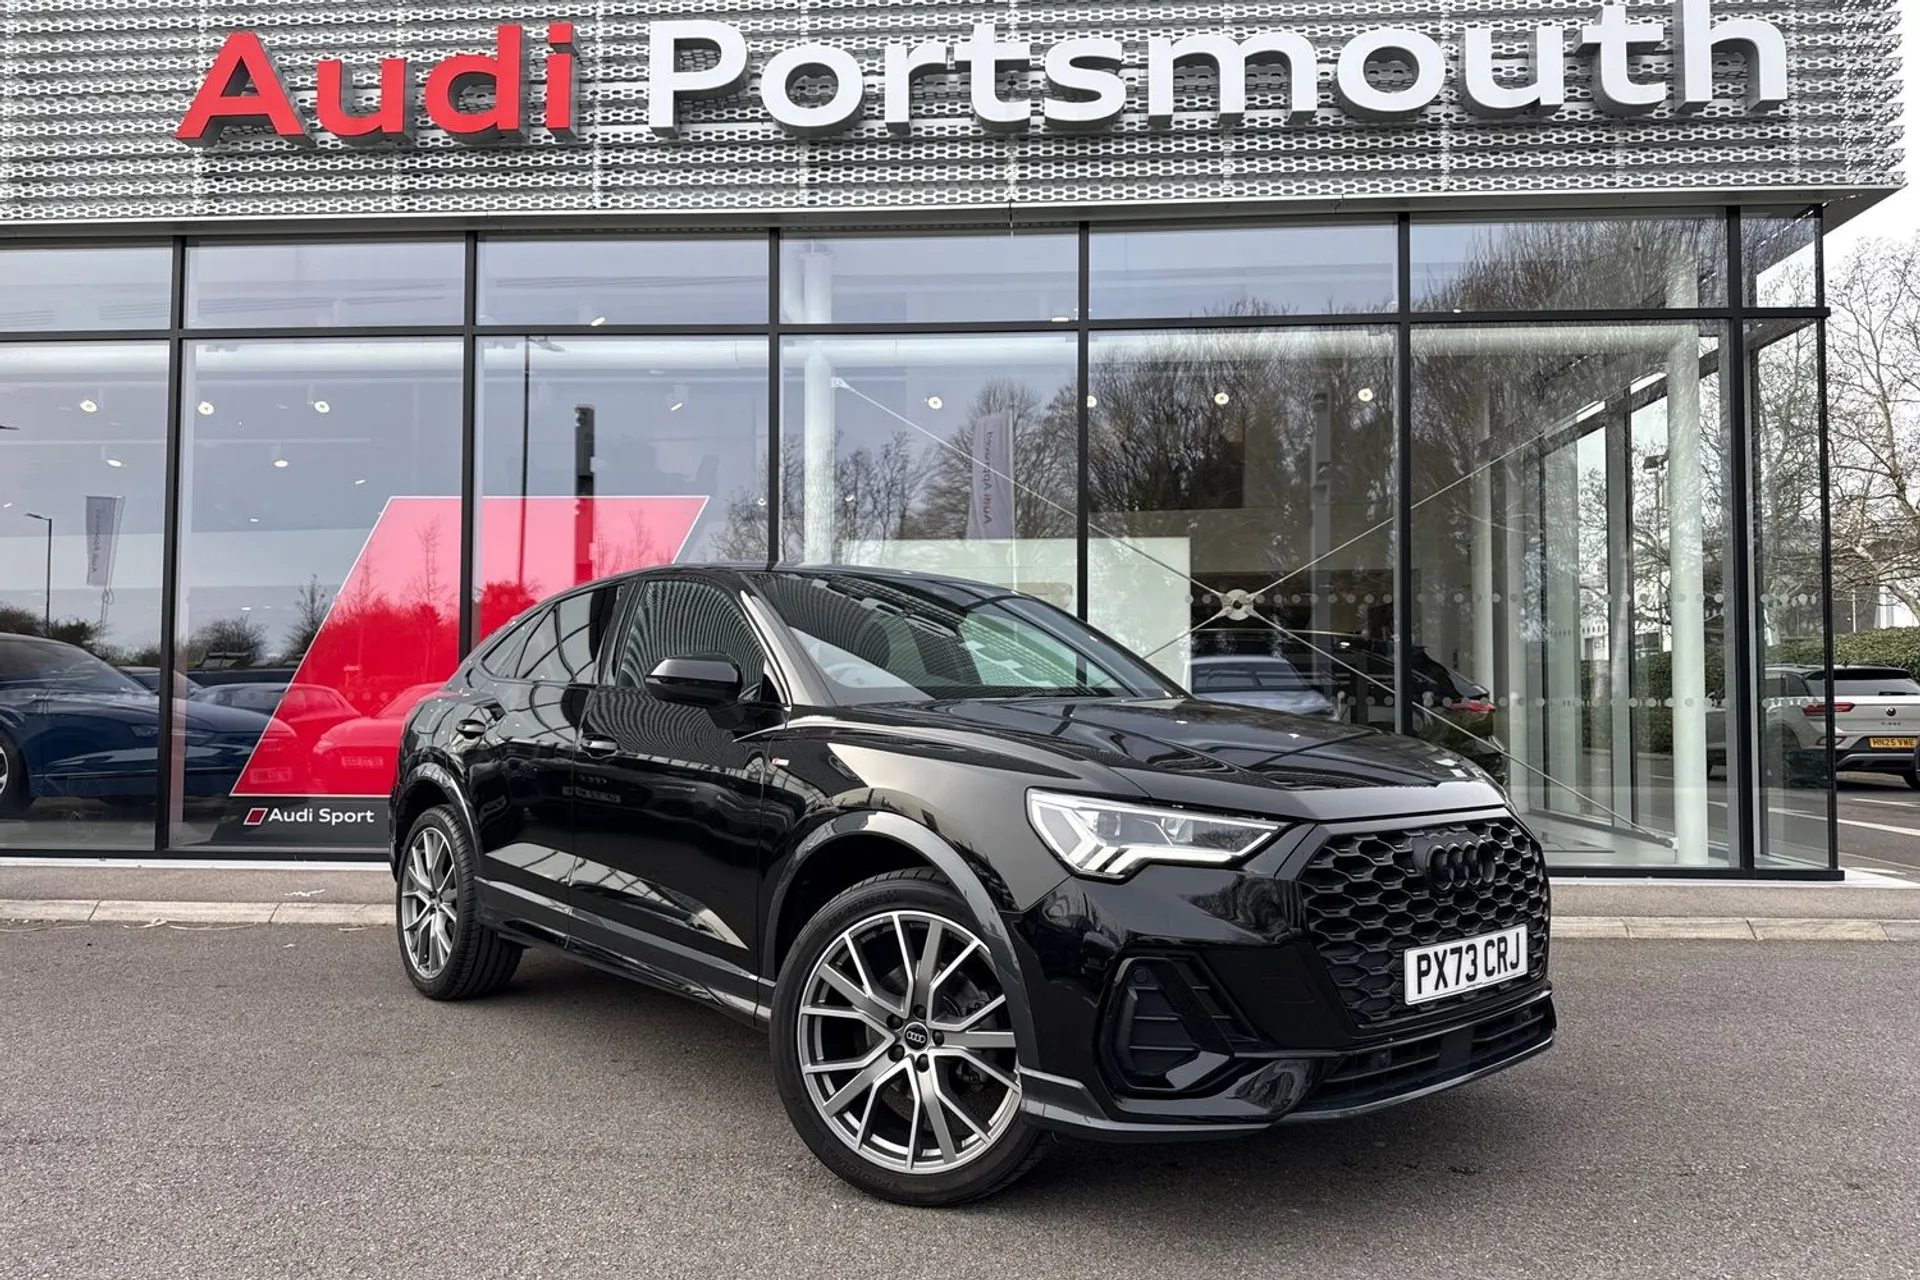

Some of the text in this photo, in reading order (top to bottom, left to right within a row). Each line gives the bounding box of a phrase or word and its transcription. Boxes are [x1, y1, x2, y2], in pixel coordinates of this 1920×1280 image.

[175, 0, 1788, 141] Audi Portsmouth
[268, 808, 375, 826] Audi Sport
[1416, 932, 1520, 995] PX73 CRJ
